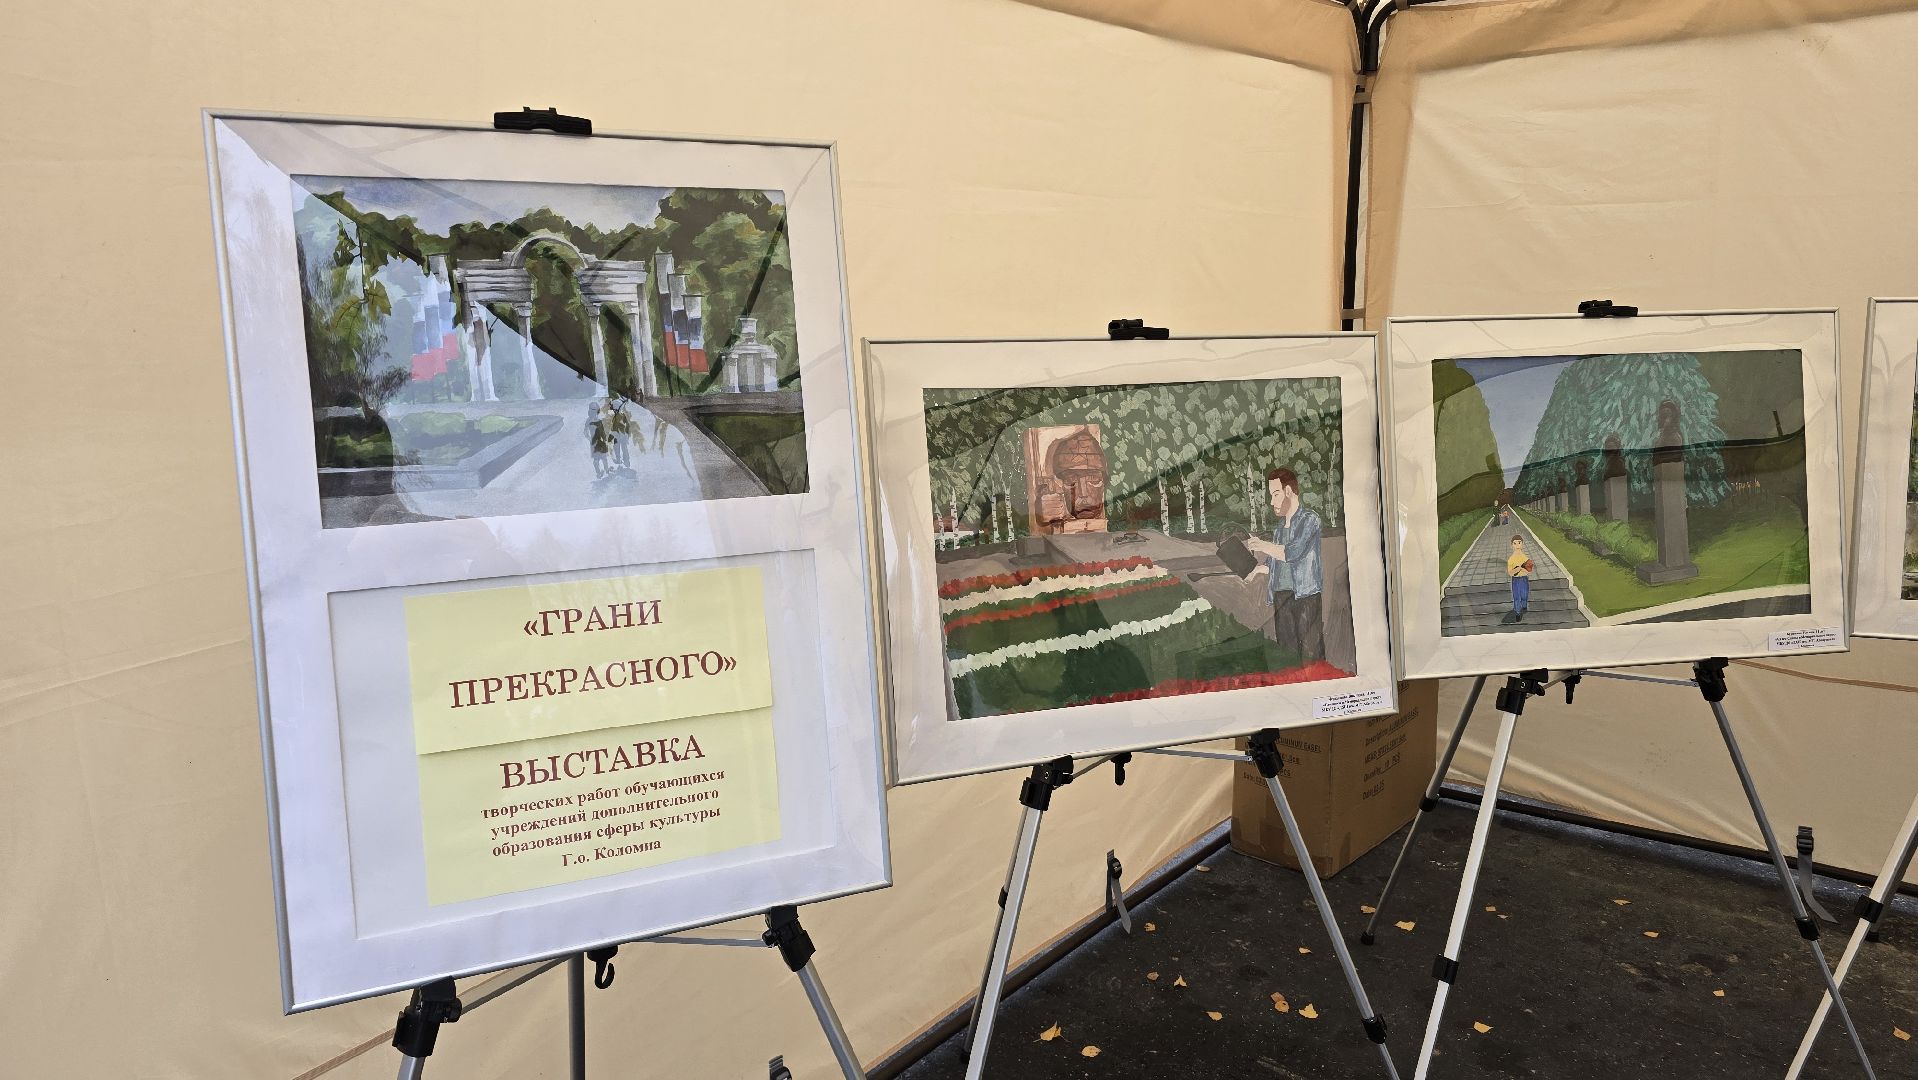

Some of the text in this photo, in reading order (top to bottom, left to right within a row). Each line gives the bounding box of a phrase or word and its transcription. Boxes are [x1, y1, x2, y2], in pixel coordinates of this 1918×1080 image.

[524, 599, 663, 637] «ГРАНИ
[449, 650, 737, 709] ПРЕКРАСНОГО»
[500, 734, 706, 790] ВЫСТАВКА
[481, 770, 725, 819] творческих работ обучающихся
[491, 789, 720, 841] учреждений дополнительного
[492, 806, 721, 857] образования сферы культуры
[561, 840, 662, 867] Г.о. Коломна
